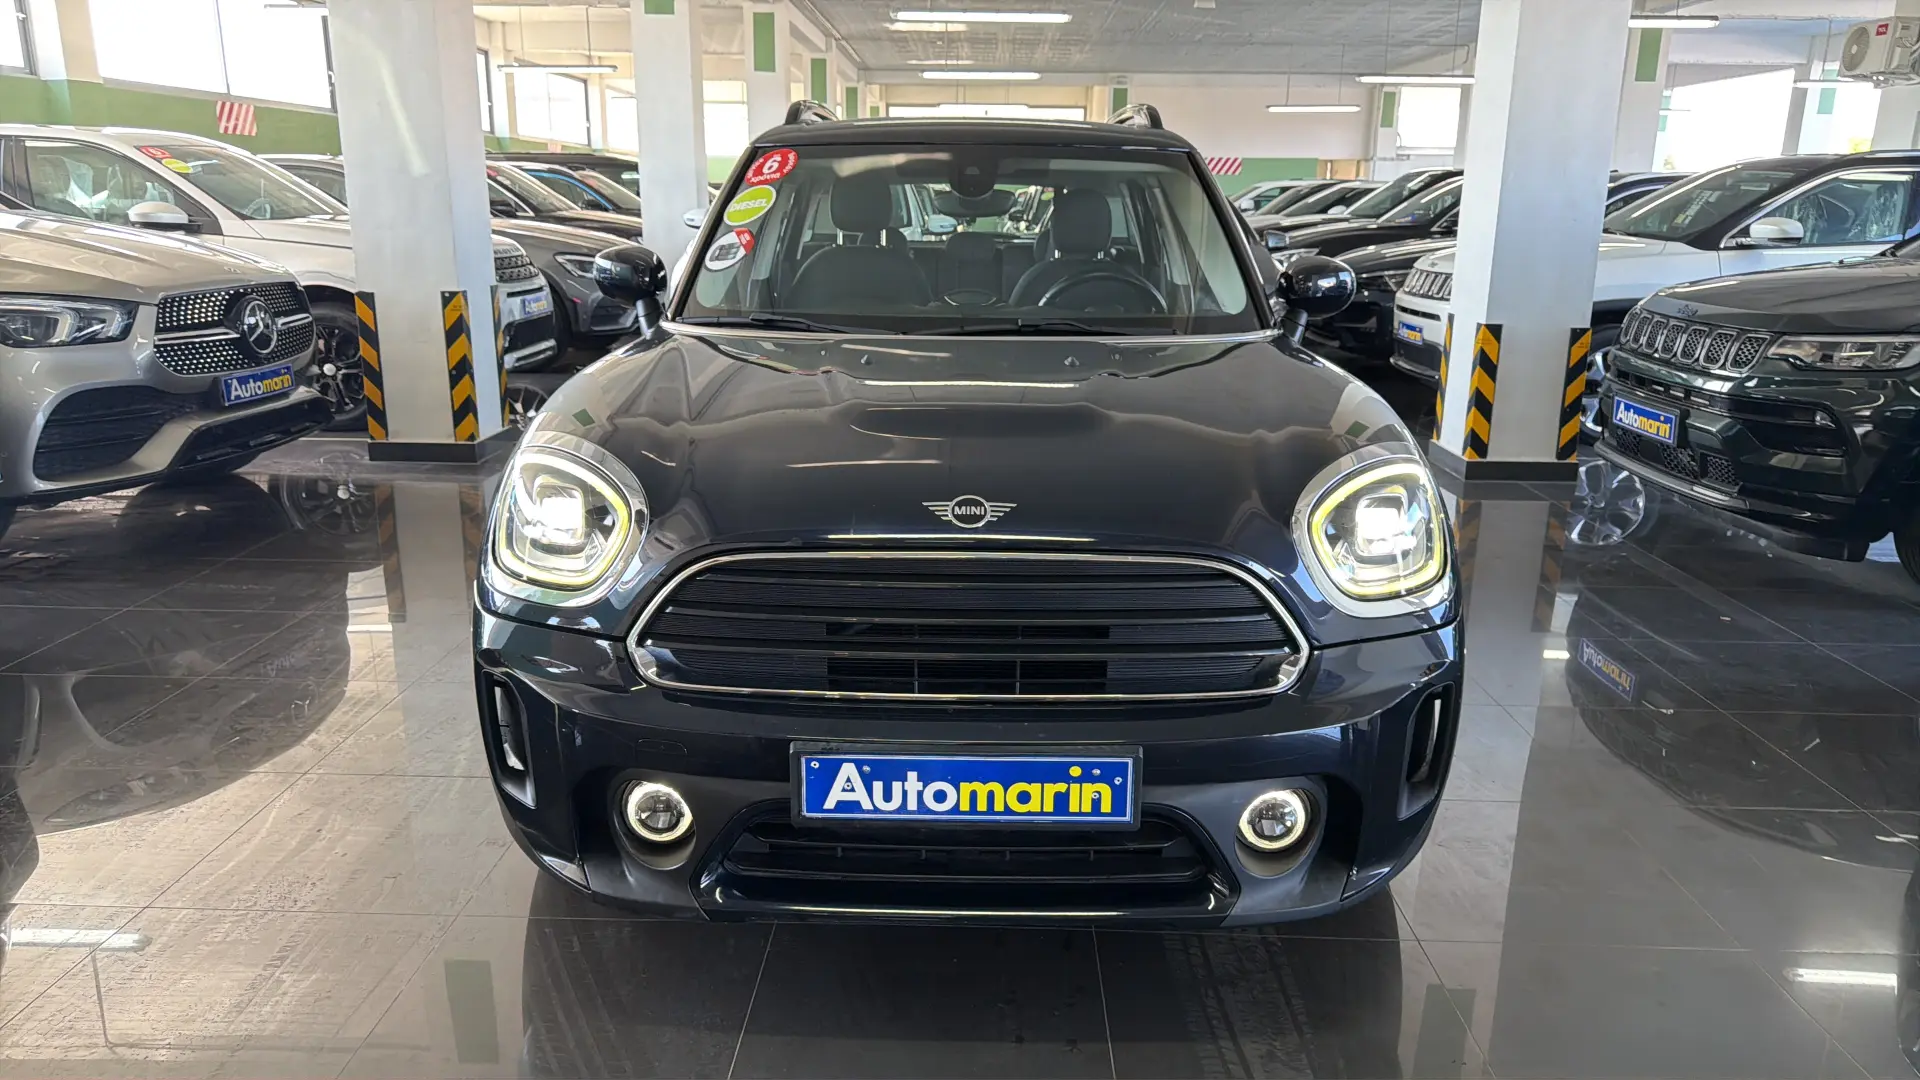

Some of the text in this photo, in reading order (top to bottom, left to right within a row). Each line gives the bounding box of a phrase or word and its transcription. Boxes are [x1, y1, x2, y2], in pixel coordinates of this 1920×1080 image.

[762, 156, 782, 174] 6
[729, 198, 768, 212] DIESEL
[231, 369, 292, 400] Automarin
[1616, 401, 1671, 438] Automarin
[953, 505, 985, 515] MINI
[822, 762, 1112, 814] Automarin
